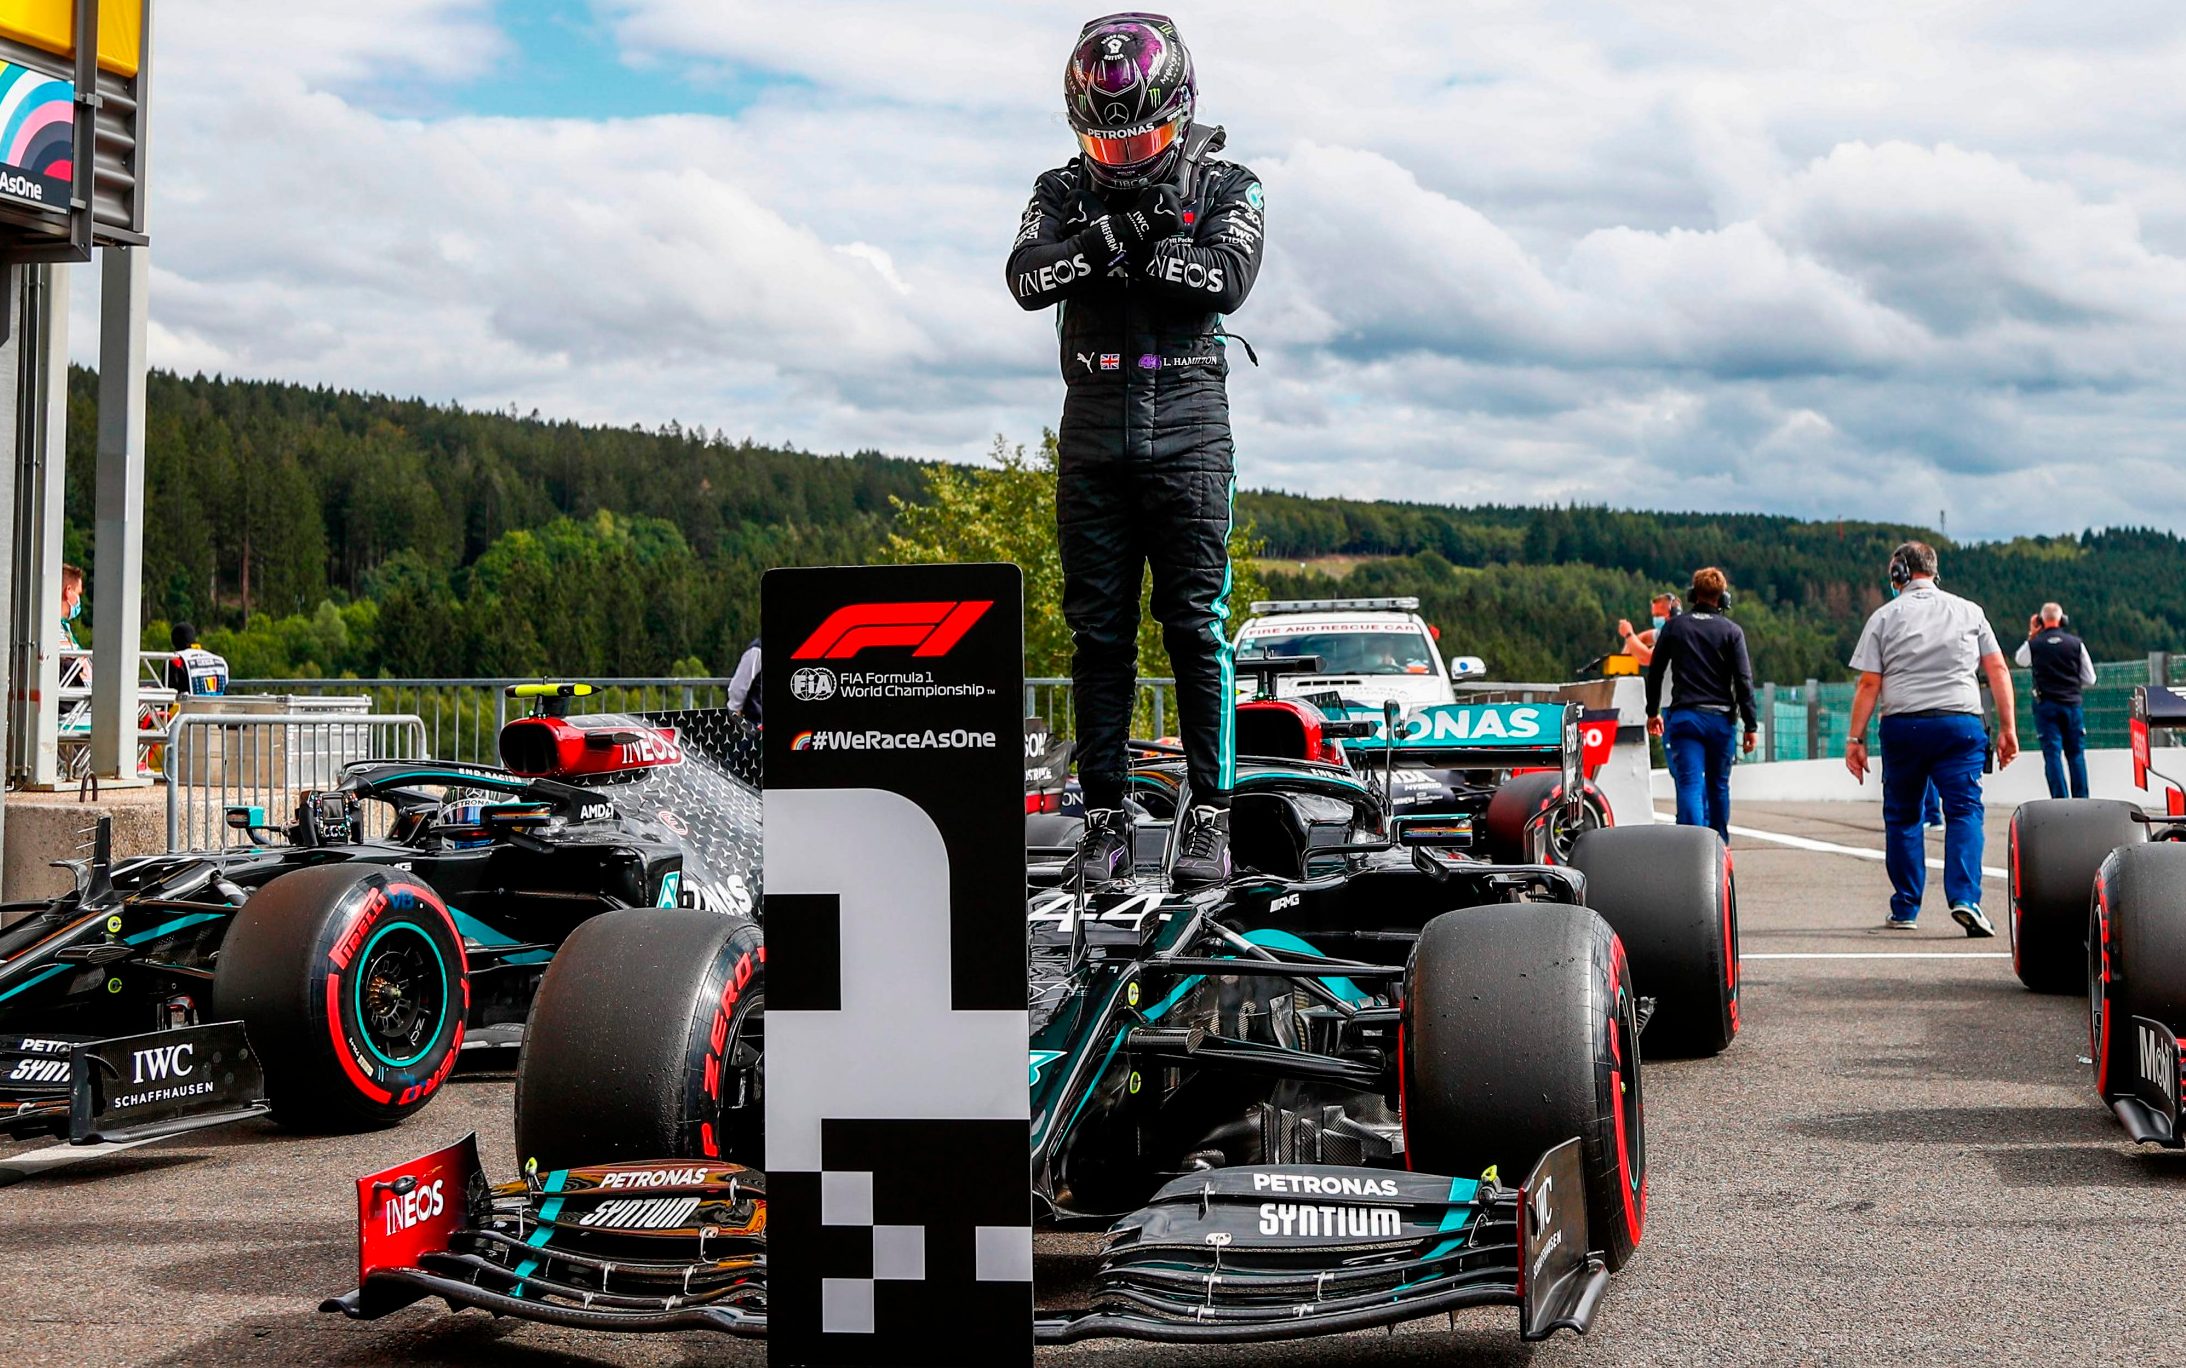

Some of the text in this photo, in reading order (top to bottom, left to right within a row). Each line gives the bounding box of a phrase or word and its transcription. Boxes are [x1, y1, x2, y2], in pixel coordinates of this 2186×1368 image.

[1087, 122, 1155, 139] PETRONAS
[1132, 210, 1150, 232] IWC
[1019, 253, 1092, 298] INEOS
[1146, 254, 1224, 293] INEOS
[1173, 355, 1217, 366] HAMILTON
[1249, 627, 1281, 636] FIRE
[1321, 624, 1380, 632] RESCUE
[1384, 624, 1415, 632] CAR
[840, 685, 882, 698] World
[885, 684, 985, 698] Championship
[841, 672, 934, 685] FIA Formula 1
[1340, 708, 1540, 741] RONAS
[622, 731, 678, 764] INEOS
[812, 729, 996, 750] #WeRaceAsOne
[1024, 766, 1053, 781] STRIKE
[1273, 893, 1300, 912] AMG
[328, 887, 388, 970] PIRELLI
[703, 952, 751, 1101] ZERO
[132, 1043, 195, 1084] IWC
[114, 1081, 214, 1109] SCHAFFHAUSEN
[599, 1168, 708, 1189] PETRONAS
[1253, 1173, 1399, 1197] PETRONAS
[385, 1179, 444, 1237] INEOS
[580, 1197, 701, 1228] SYNTIUM
[1258, 1202, 1402, 1237] SYNTIUM
